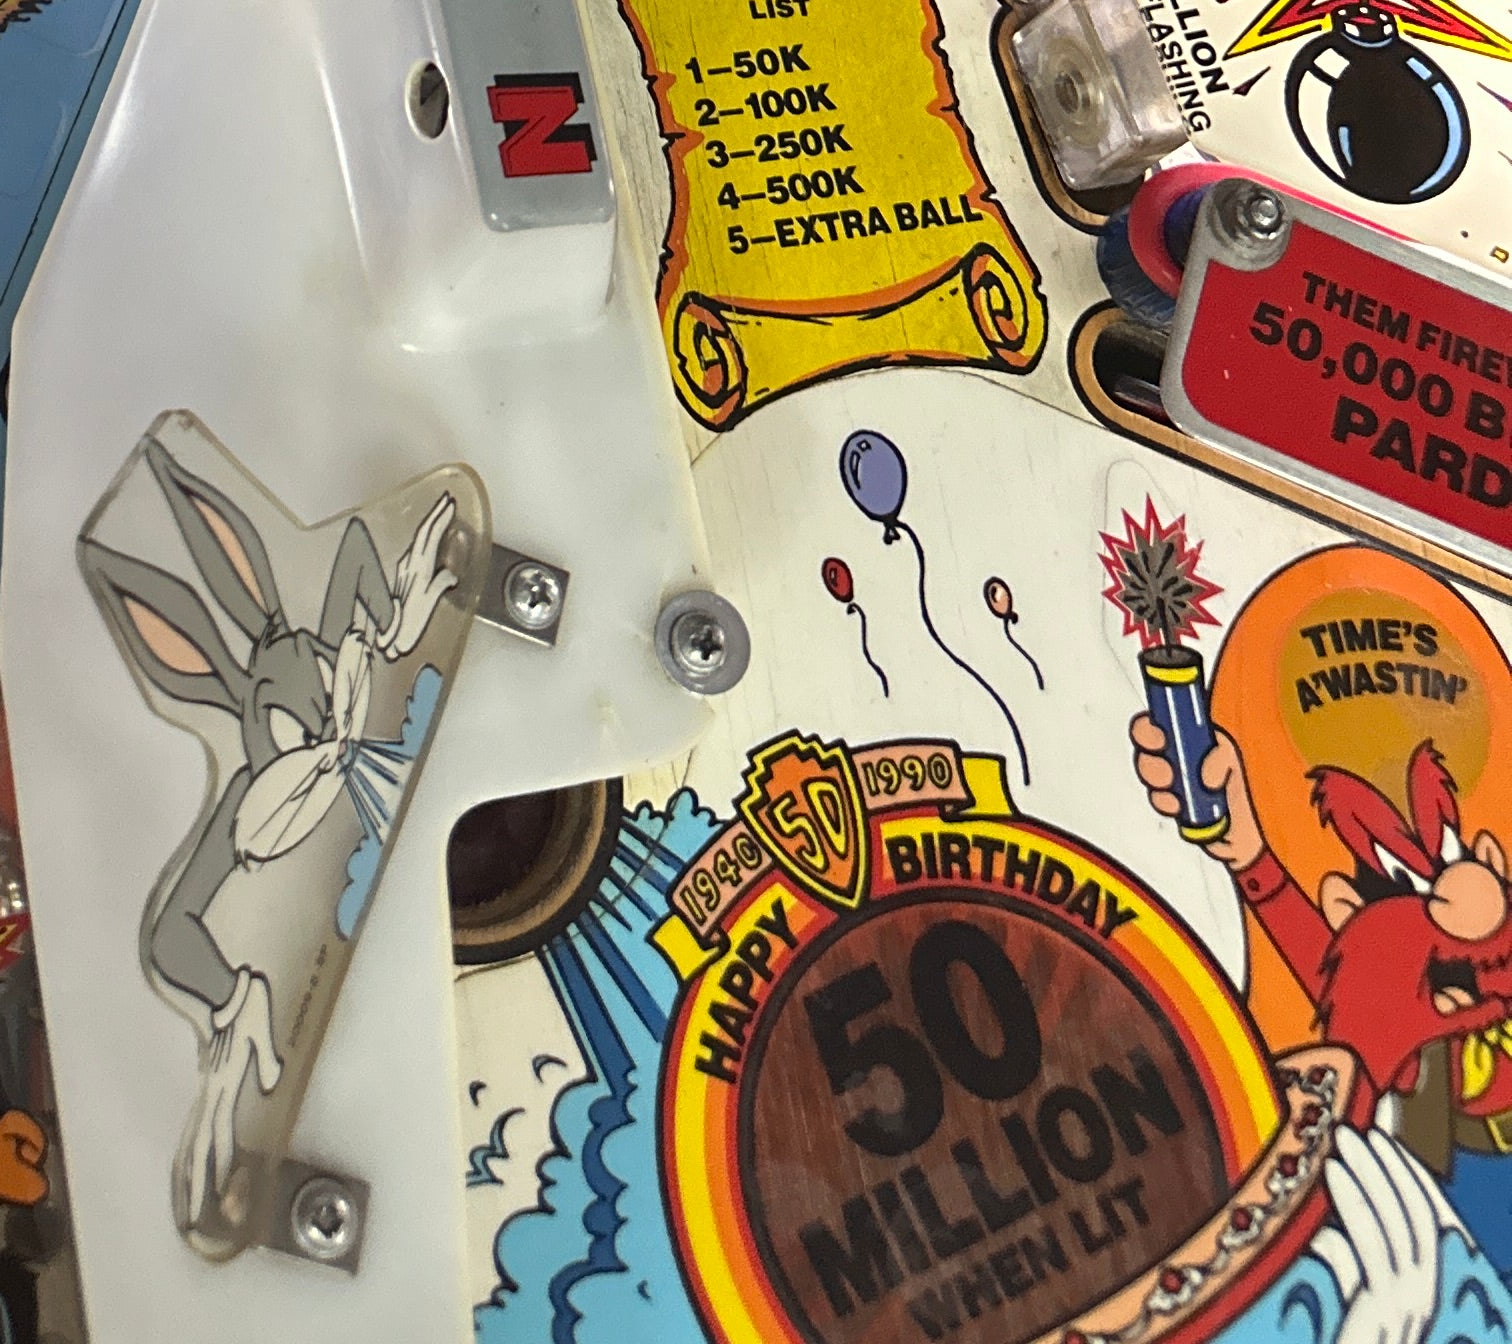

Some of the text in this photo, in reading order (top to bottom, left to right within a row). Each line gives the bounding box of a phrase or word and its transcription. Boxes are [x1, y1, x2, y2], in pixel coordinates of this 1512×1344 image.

[893, 193, 984, 232] BALL
[1249, 300, 1455, 418] 50,000
[1302, 270, 1512, 389] THEM FIRE
[1295, 659, 1469, 714] A'WASTIN'
[1299, 618, 1439, 658] TIME'S
[861, 752, 955, 797] 1990
[679, 830, 764, 926] 1940
[694, 831, 1140, 1084] HAPPY BIRTHDAY
[803, 919, 1043, 1159] 50
[797, 1043, 1187, 1320] MILLION
[904, 1177, 1151, 1342] WHEN LIT
